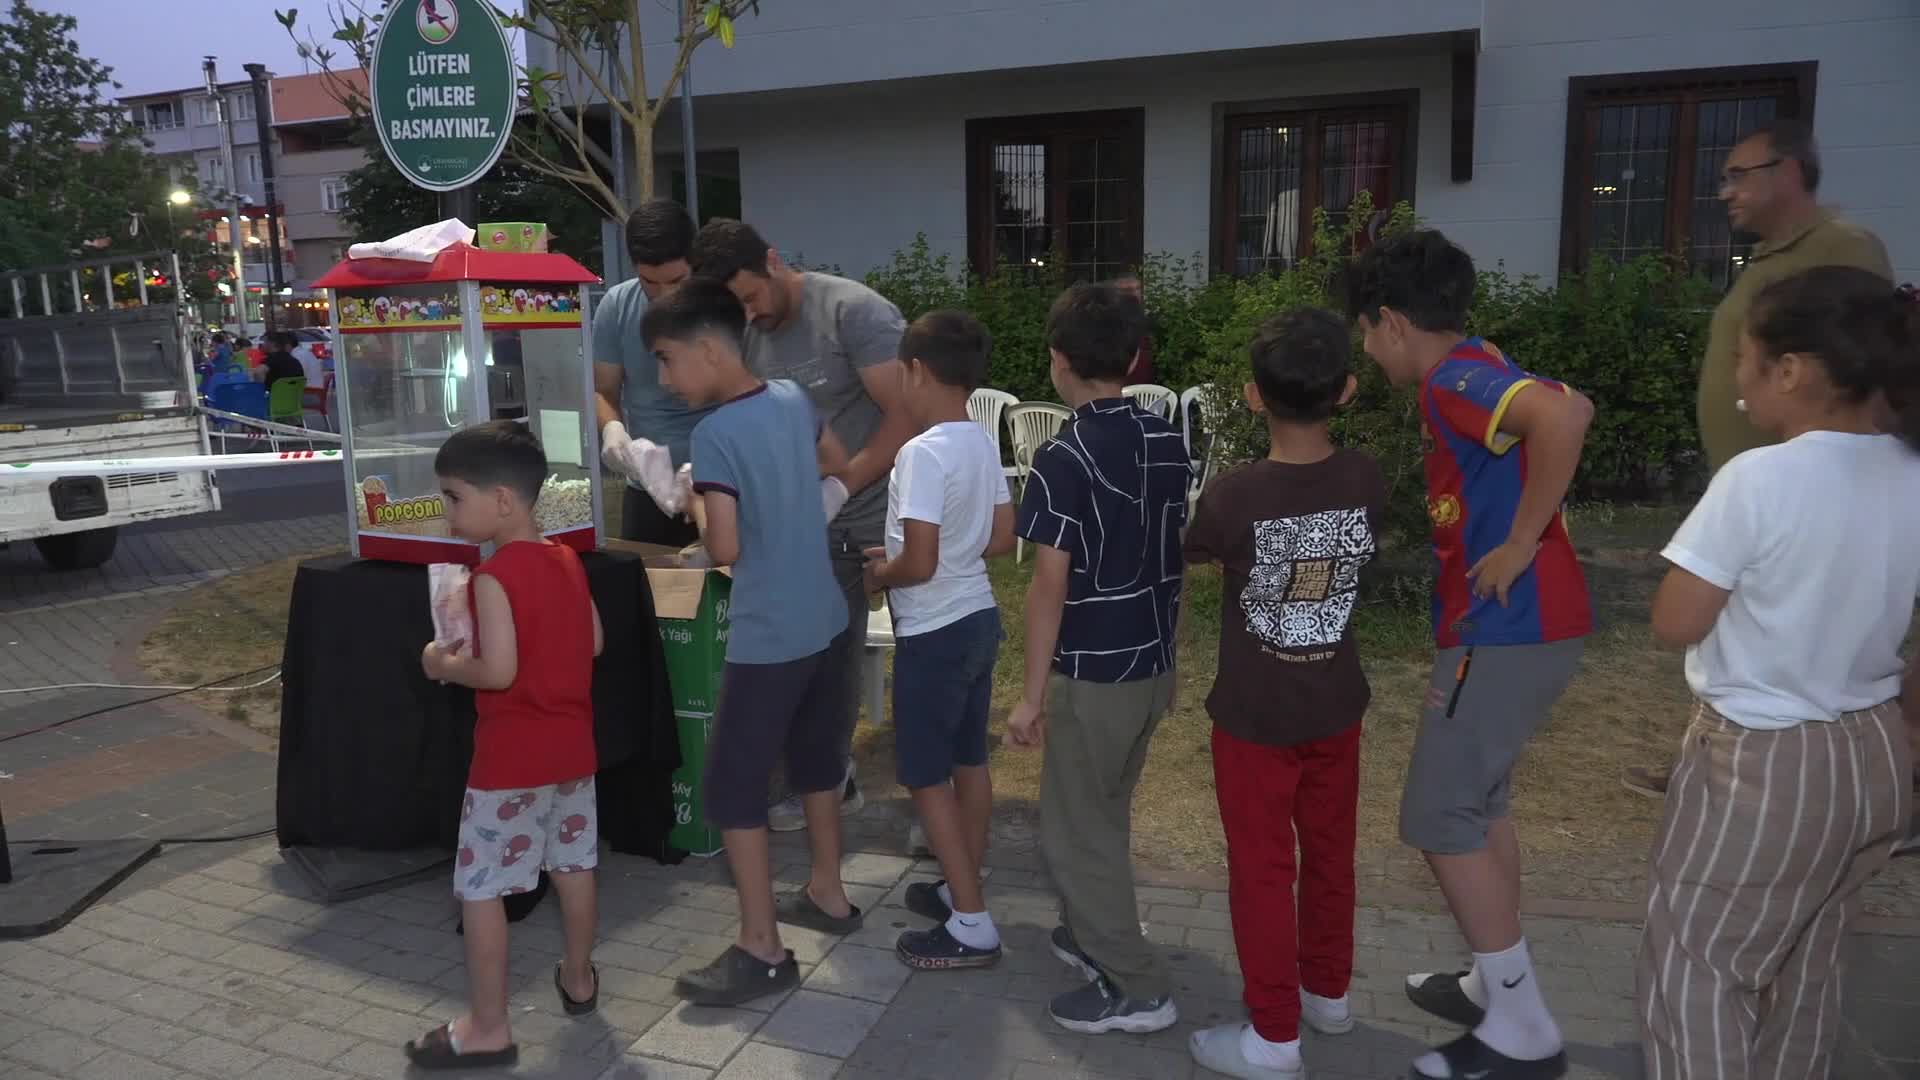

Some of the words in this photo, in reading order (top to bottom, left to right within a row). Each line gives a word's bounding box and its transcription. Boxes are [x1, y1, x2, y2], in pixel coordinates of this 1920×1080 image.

[408, 51, 471, 76] LÜTFEN
[406, 83, 476, 111] ÇİMLERE
[391, 117, 496, 140] BASMAYINIZ.
[375, 499, 443, 523] POPCORN
[1296, 560, 1331, 574] STAY
[1288, 590, 1325, 600] TRUE
